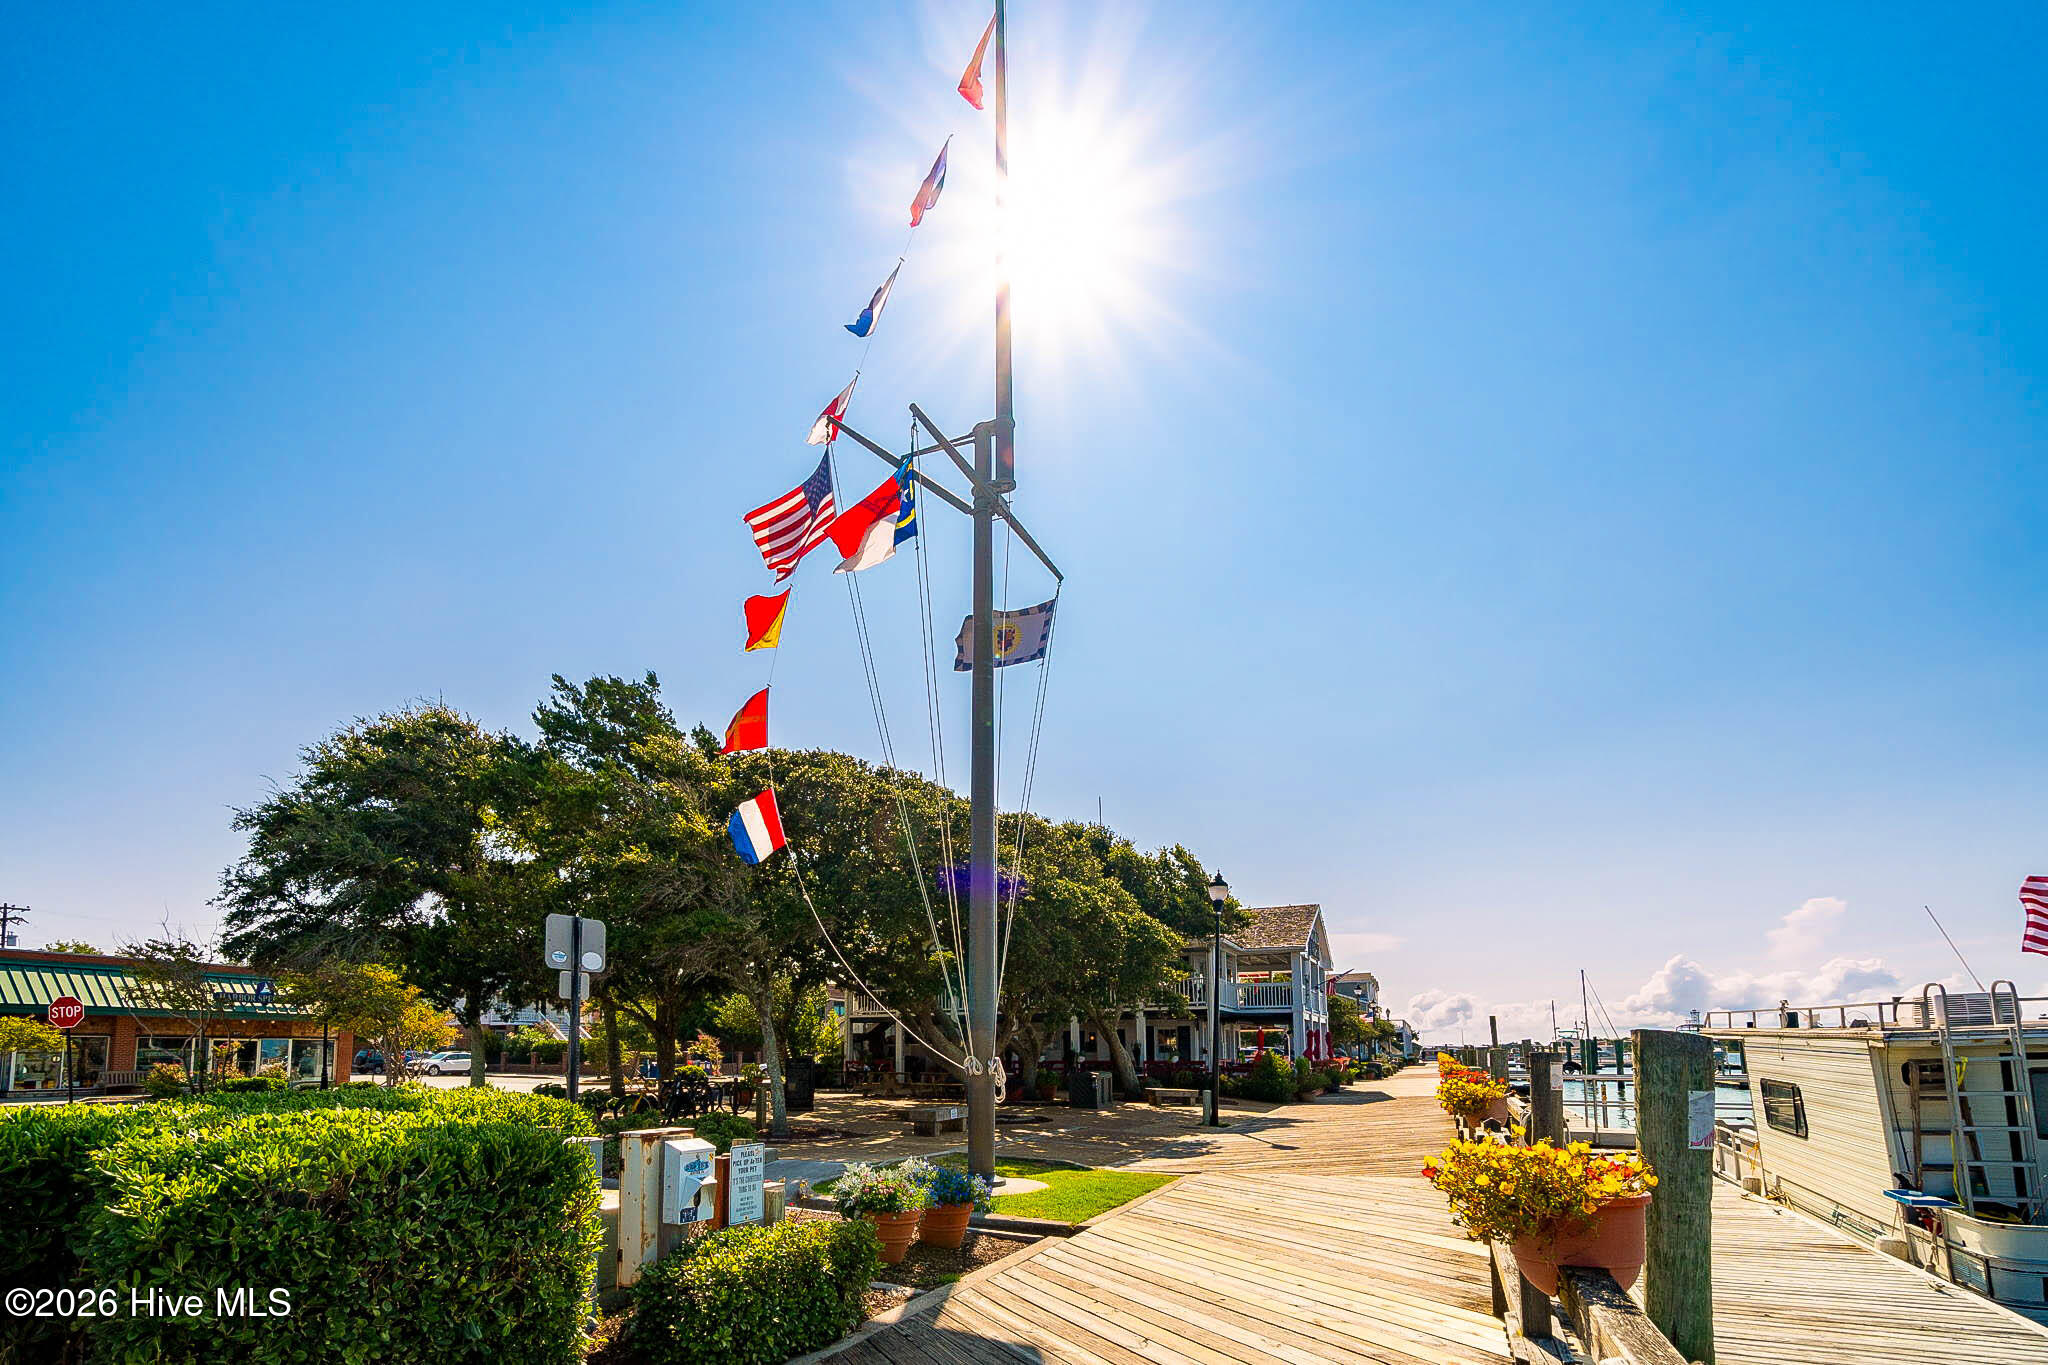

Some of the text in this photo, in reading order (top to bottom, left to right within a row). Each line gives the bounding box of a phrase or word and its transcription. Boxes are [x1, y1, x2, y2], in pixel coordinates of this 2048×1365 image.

[219, 993, 256, 1002] HARBOR
[51, 1005, 82, 1019] STOP
[732, 1159, 743, 1167] PICK
